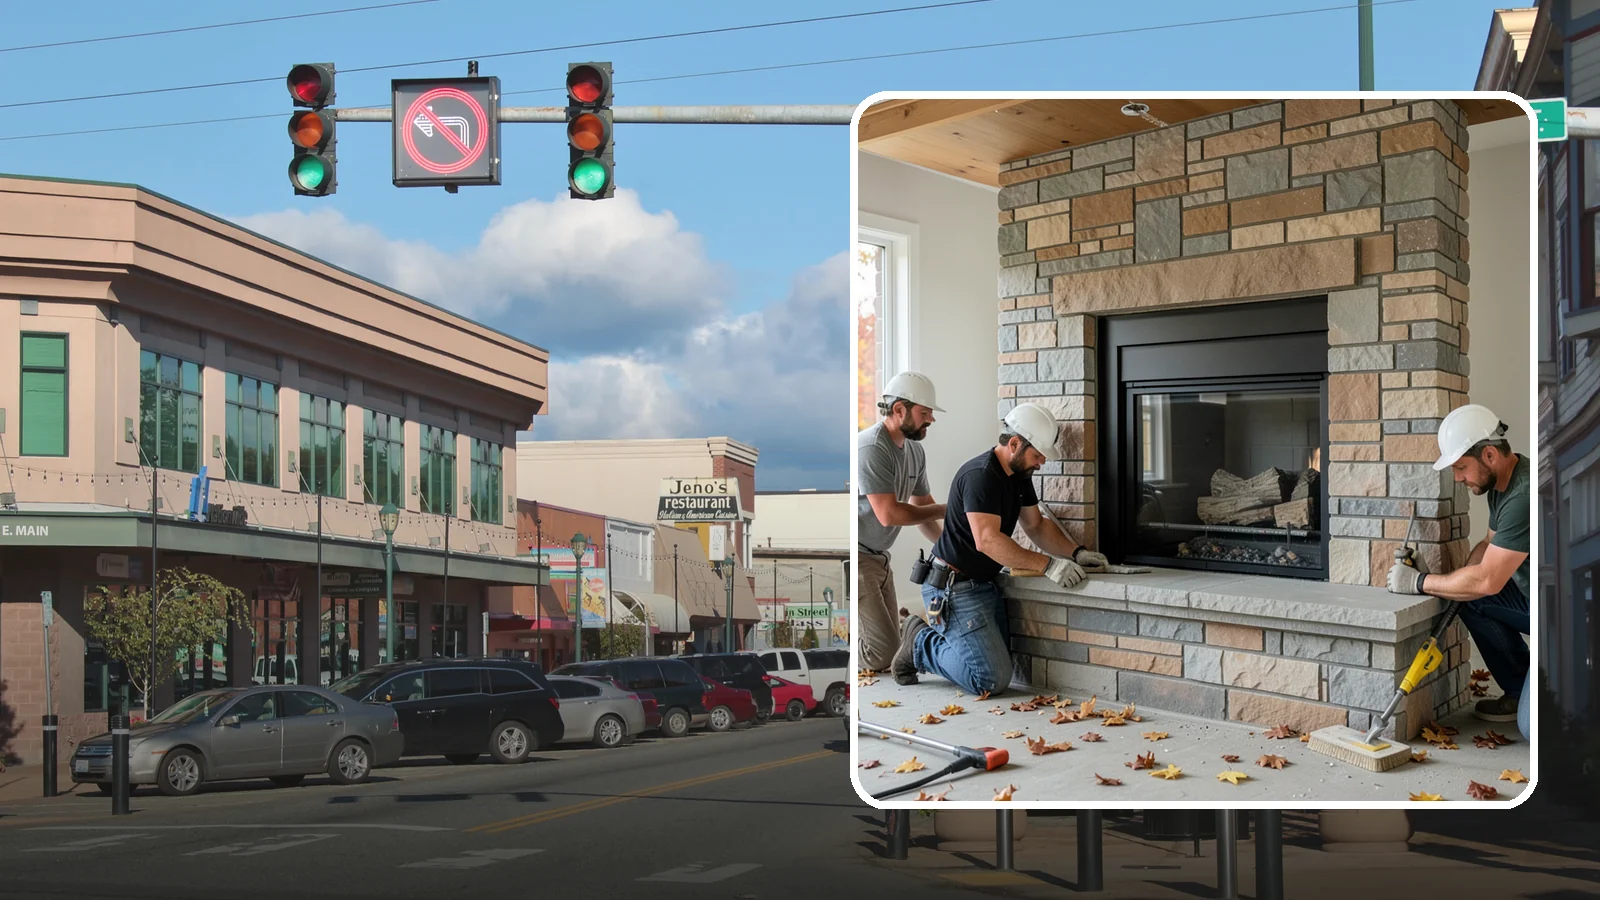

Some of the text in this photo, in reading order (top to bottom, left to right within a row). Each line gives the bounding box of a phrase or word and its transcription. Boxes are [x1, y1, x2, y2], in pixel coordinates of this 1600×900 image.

[669, 480, 727, 495] Jeno's
[665, 497, 731, 509] restaurant
[658, 509, 681, 520] Italian
[686, 509, 714, 519] American
[715, 509, 738, 519] Cuisine
[2, 525, 49, 536] E. MAIN
[797, 607, 828, 617] Street
